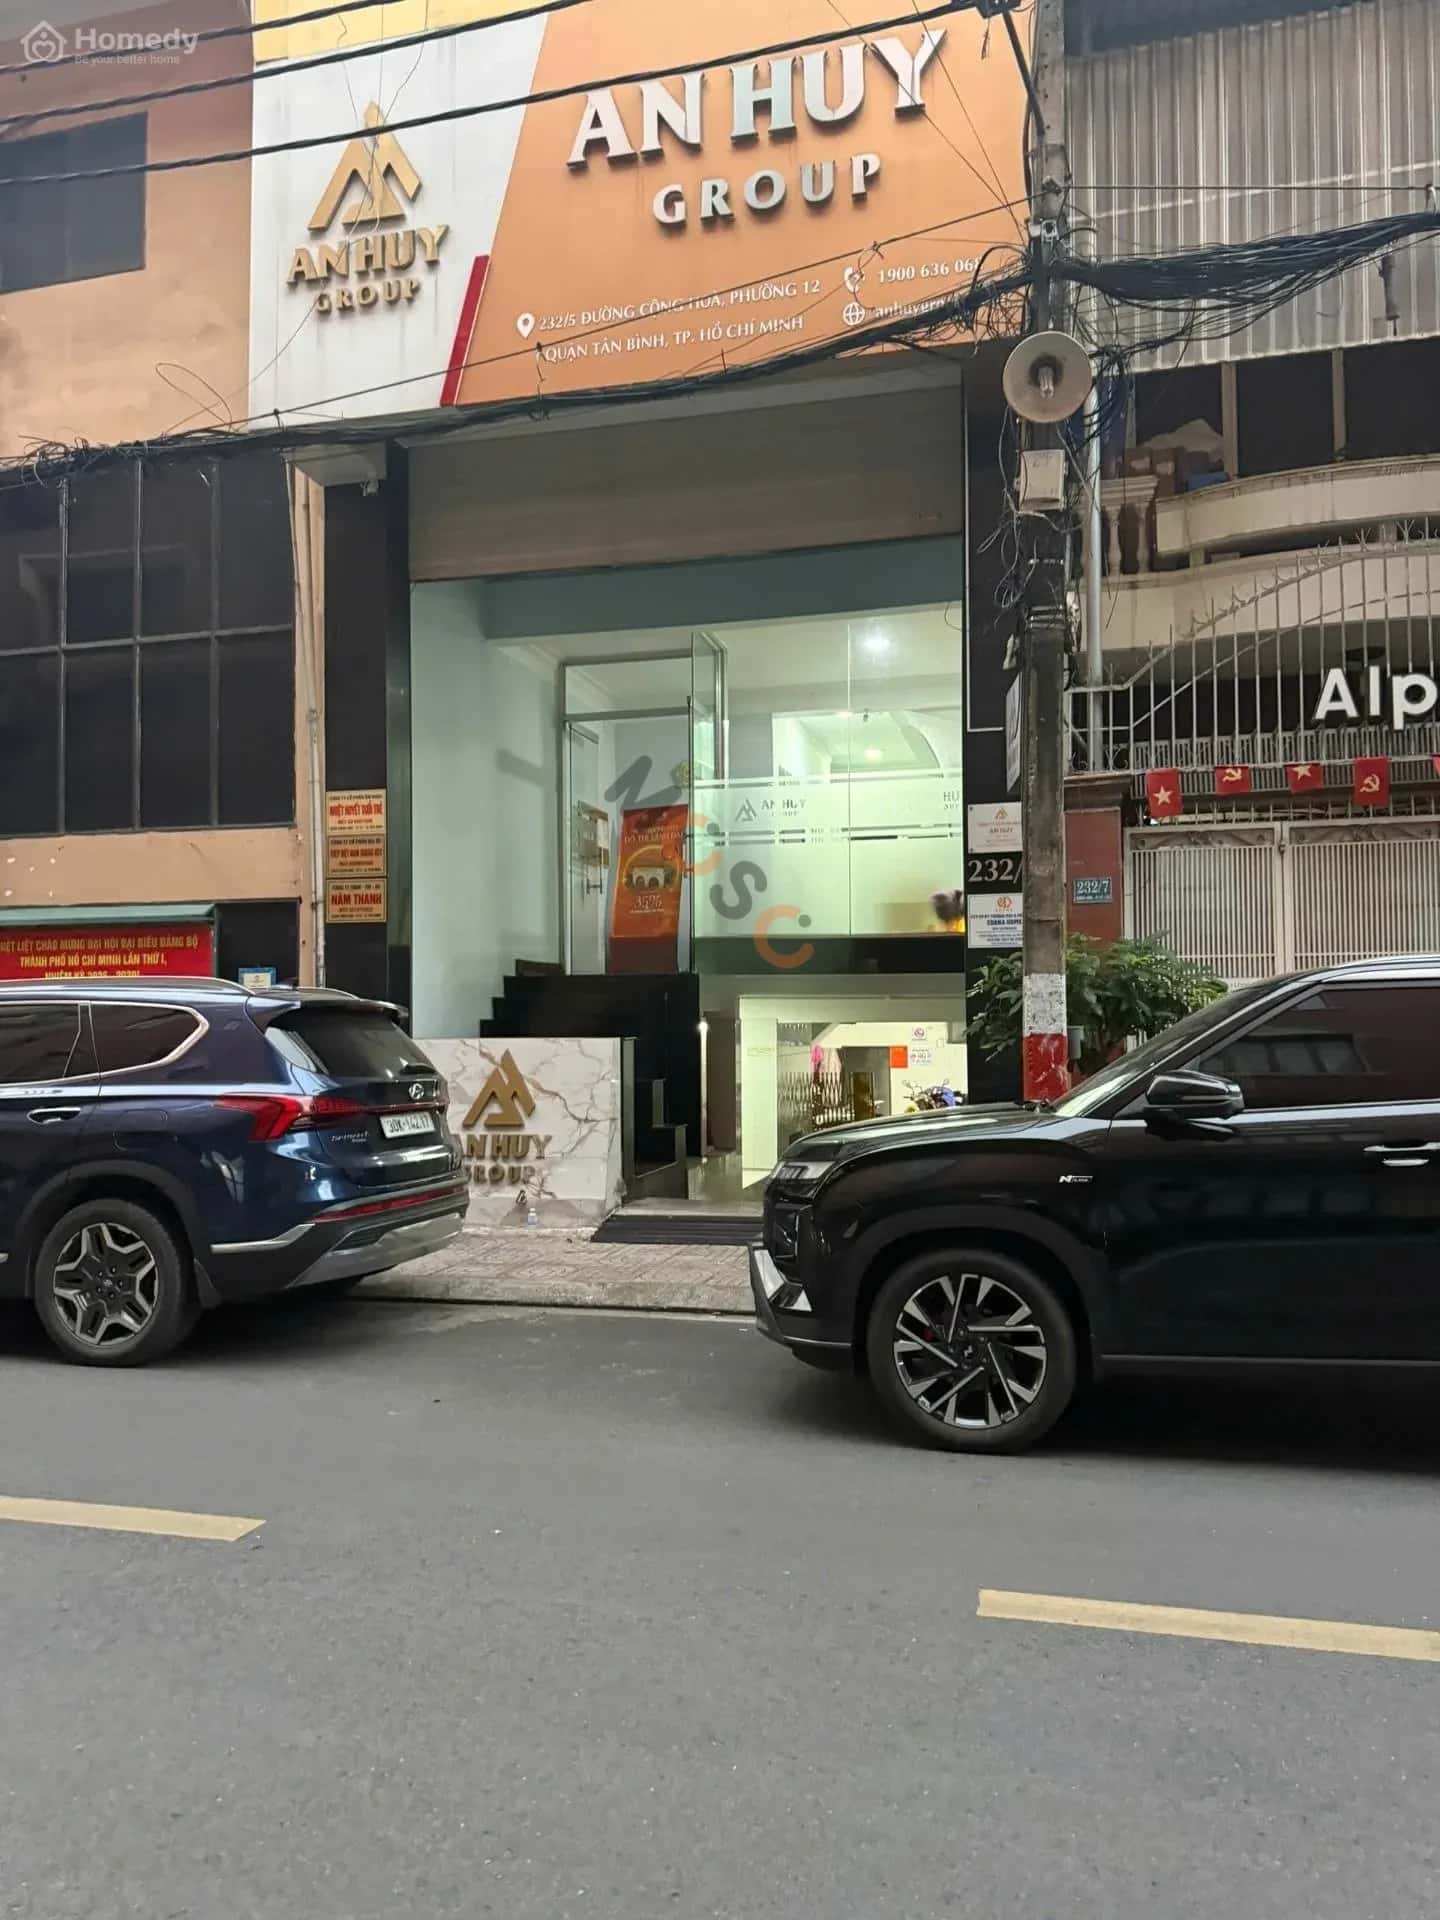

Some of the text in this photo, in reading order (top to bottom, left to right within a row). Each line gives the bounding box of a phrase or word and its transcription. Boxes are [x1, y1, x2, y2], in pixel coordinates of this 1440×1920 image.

[652, 152, 882, 227] GROUP
[879, 266, 915, 284] 1900
[920, 263, 949, 279] 636
[316, 279, 420, 313] GROUP
[538, 315, 577, 332] 232/5
[581, 304, 635, 325] ĐƯỜNG
[730, 281, 797, 306] PHƯỜNG
[803, 279, 820, 295] 12
[544, 316, 804, 365] QUẬN TÂN BÌNH, TP. HỒ CHÍ MINH
[1312, 665, 1438, 731] Alp
[1076, 880, 1110, 894] 232/7
[17, 937, 33, 954] LIỆT
[20, 953, 47, 968] THÀNH
[49, 952, 66, 967] PHỐ
[82, 951, 96, 966] CHÍ
[98, 953, 121, 966] MINH
[143, 950, 160, 965] THỨ
